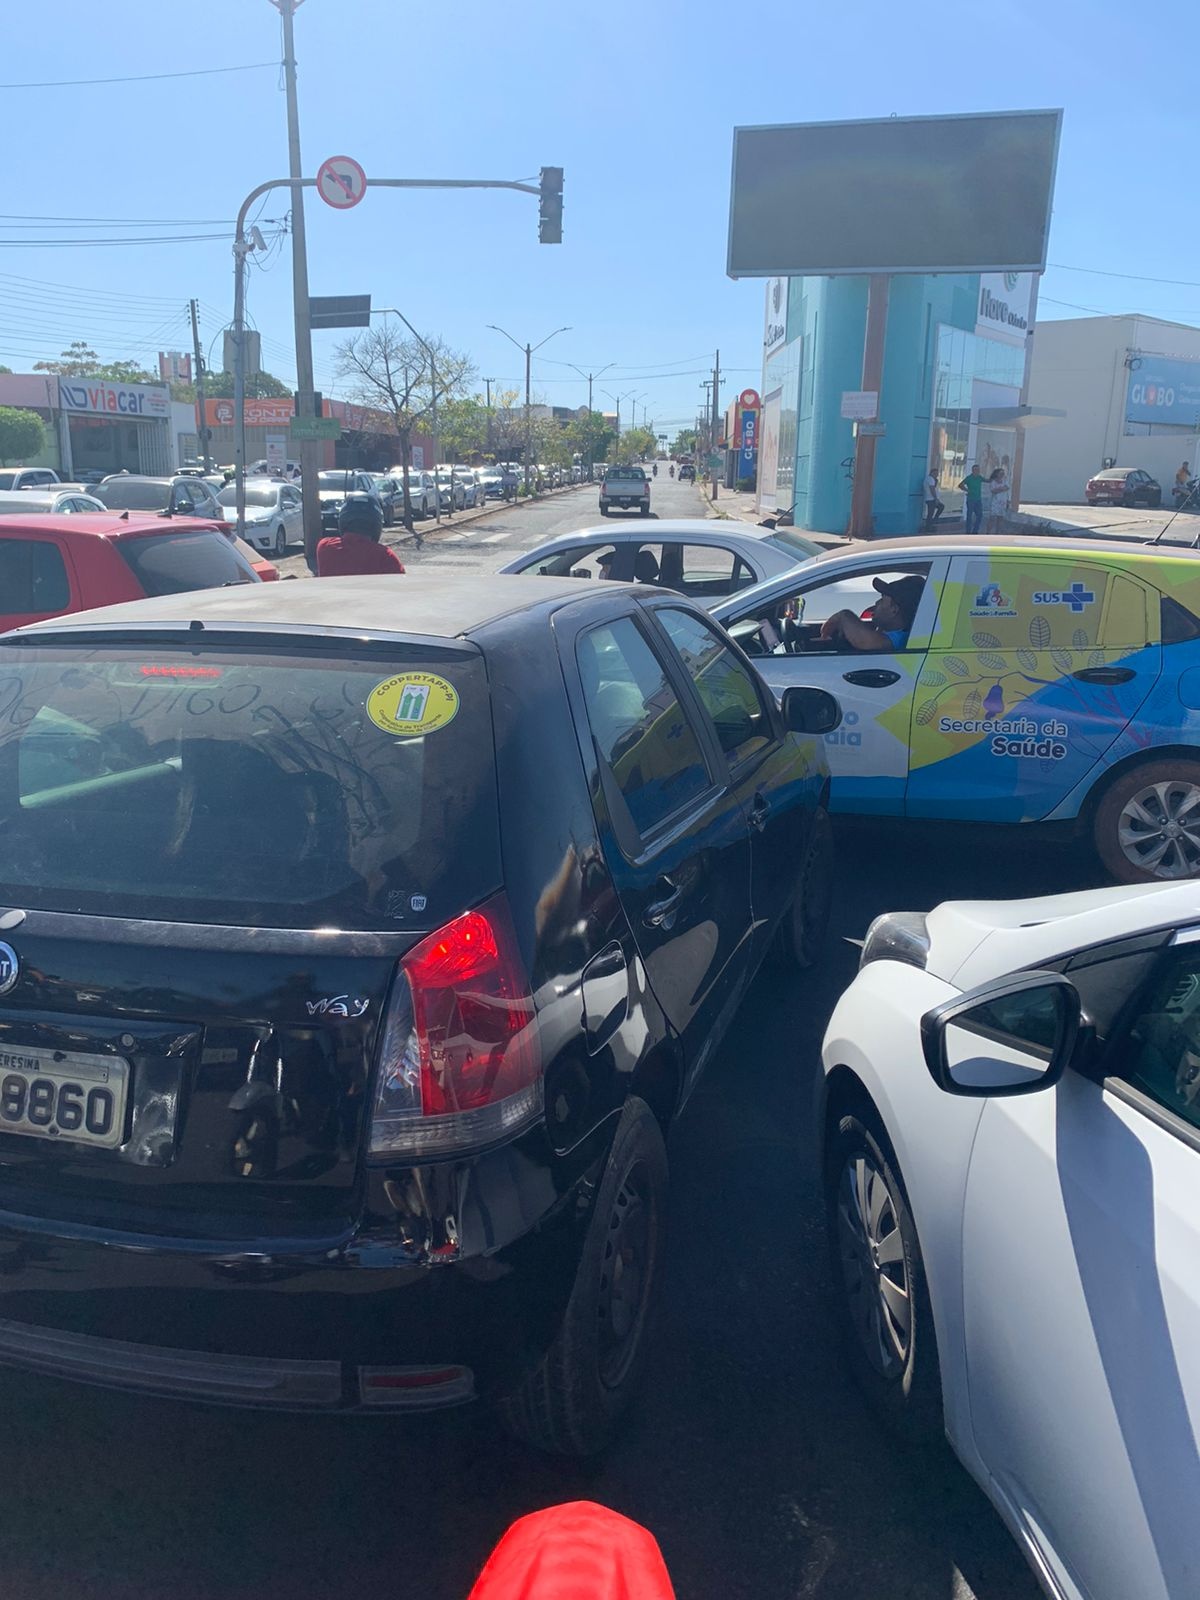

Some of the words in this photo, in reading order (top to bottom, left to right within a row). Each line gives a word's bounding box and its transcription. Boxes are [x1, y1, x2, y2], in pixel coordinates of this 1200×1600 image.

[88, 382, 144, 413] viacar
[1033, 592, 1060, 603] SUS
[939, 717, 1037, 735] Secretaria
[1042, 719, 1067, 736] da
[991, 736, 1066, 759] Saúde
[1, 1074, 115, 1136] 8860
